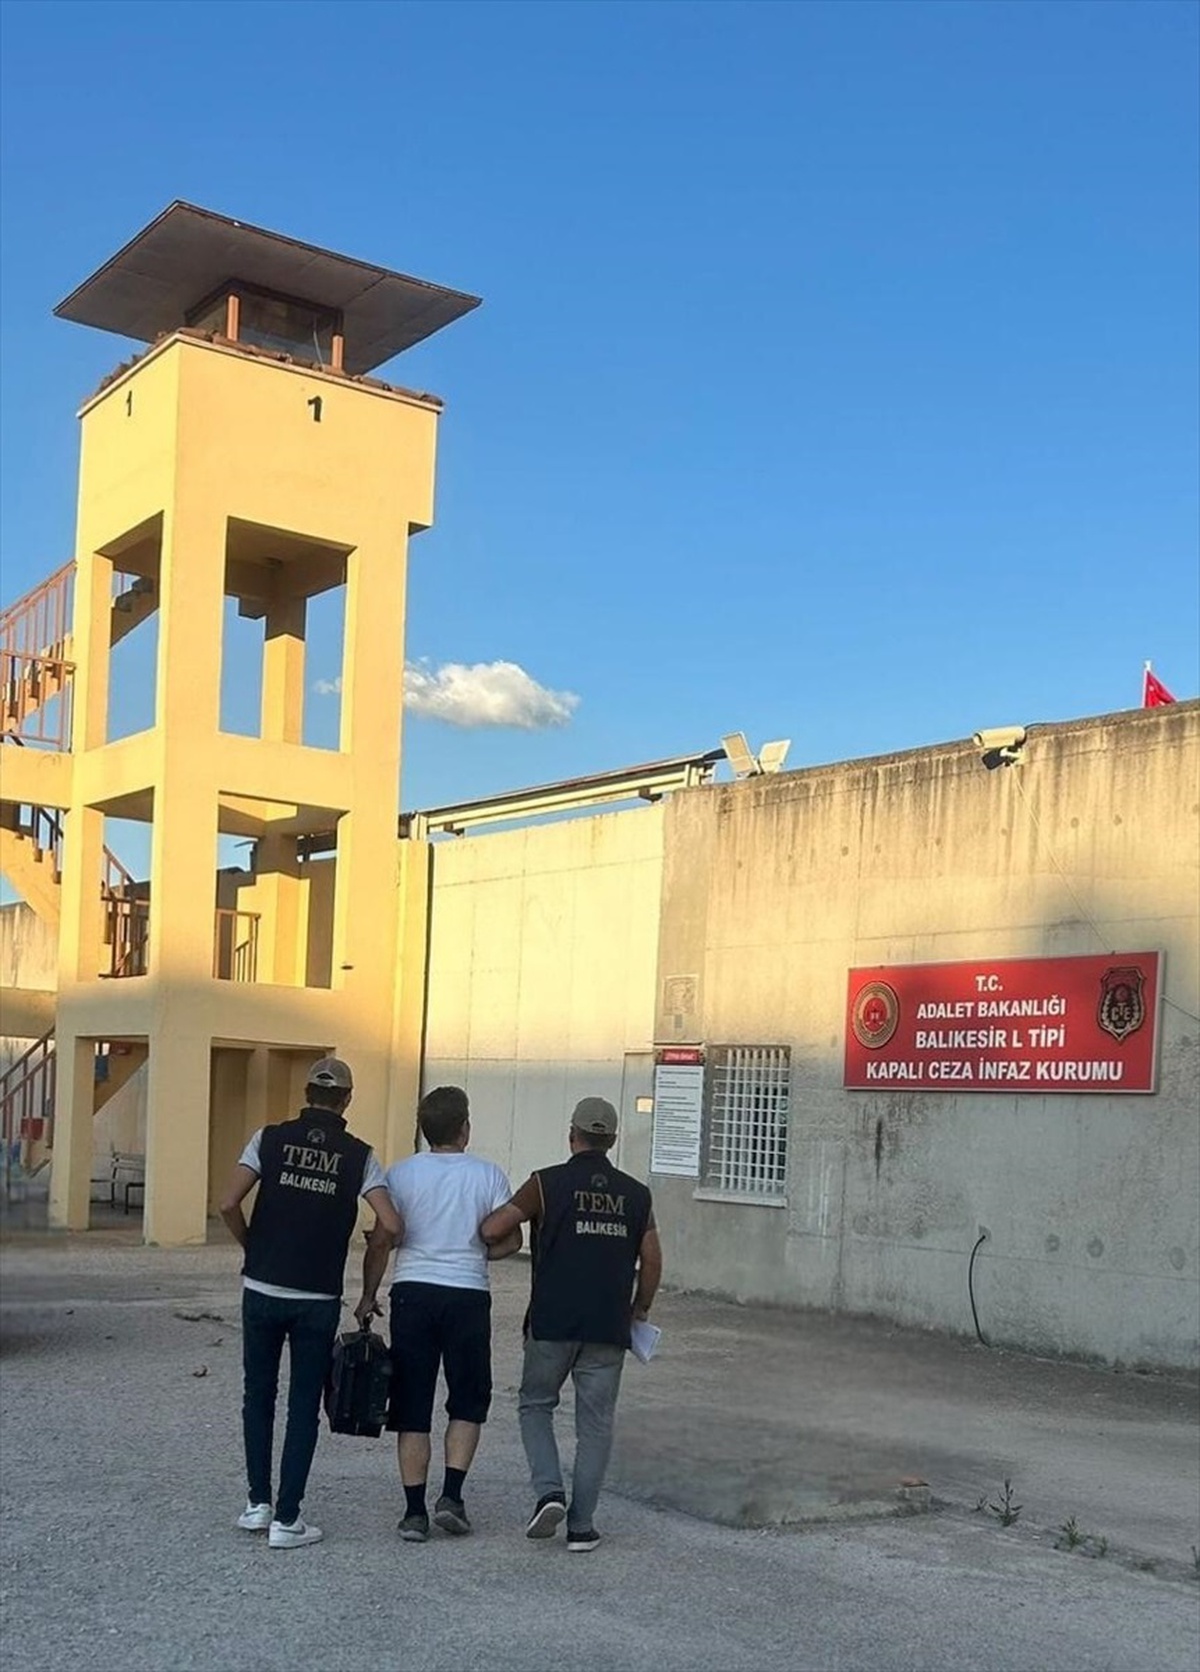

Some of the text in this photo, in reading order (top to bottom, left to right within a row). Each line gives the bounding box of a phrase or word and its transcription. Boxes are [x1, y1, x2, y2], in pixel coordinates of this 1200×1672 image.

[308, 395, 323, 423] 1
[975, 975, 1003, 992] T.C.
[916, 994, 1066, 1020] ADALET BAKANLIĞI
[915, 1024, 1066, 1049] BALIKESİR L TİPİ
[866, 1057, 1124, 1081] KAPALI CEZA İNFAZ KURUMU
[283, 1144, 343, 1175] TEM
[279, 1171, 337, 1196] BALIKESİR
[574, 1190, 626, 1216] TEM
[576, 1220, 628, 1238] BALIKESİR
